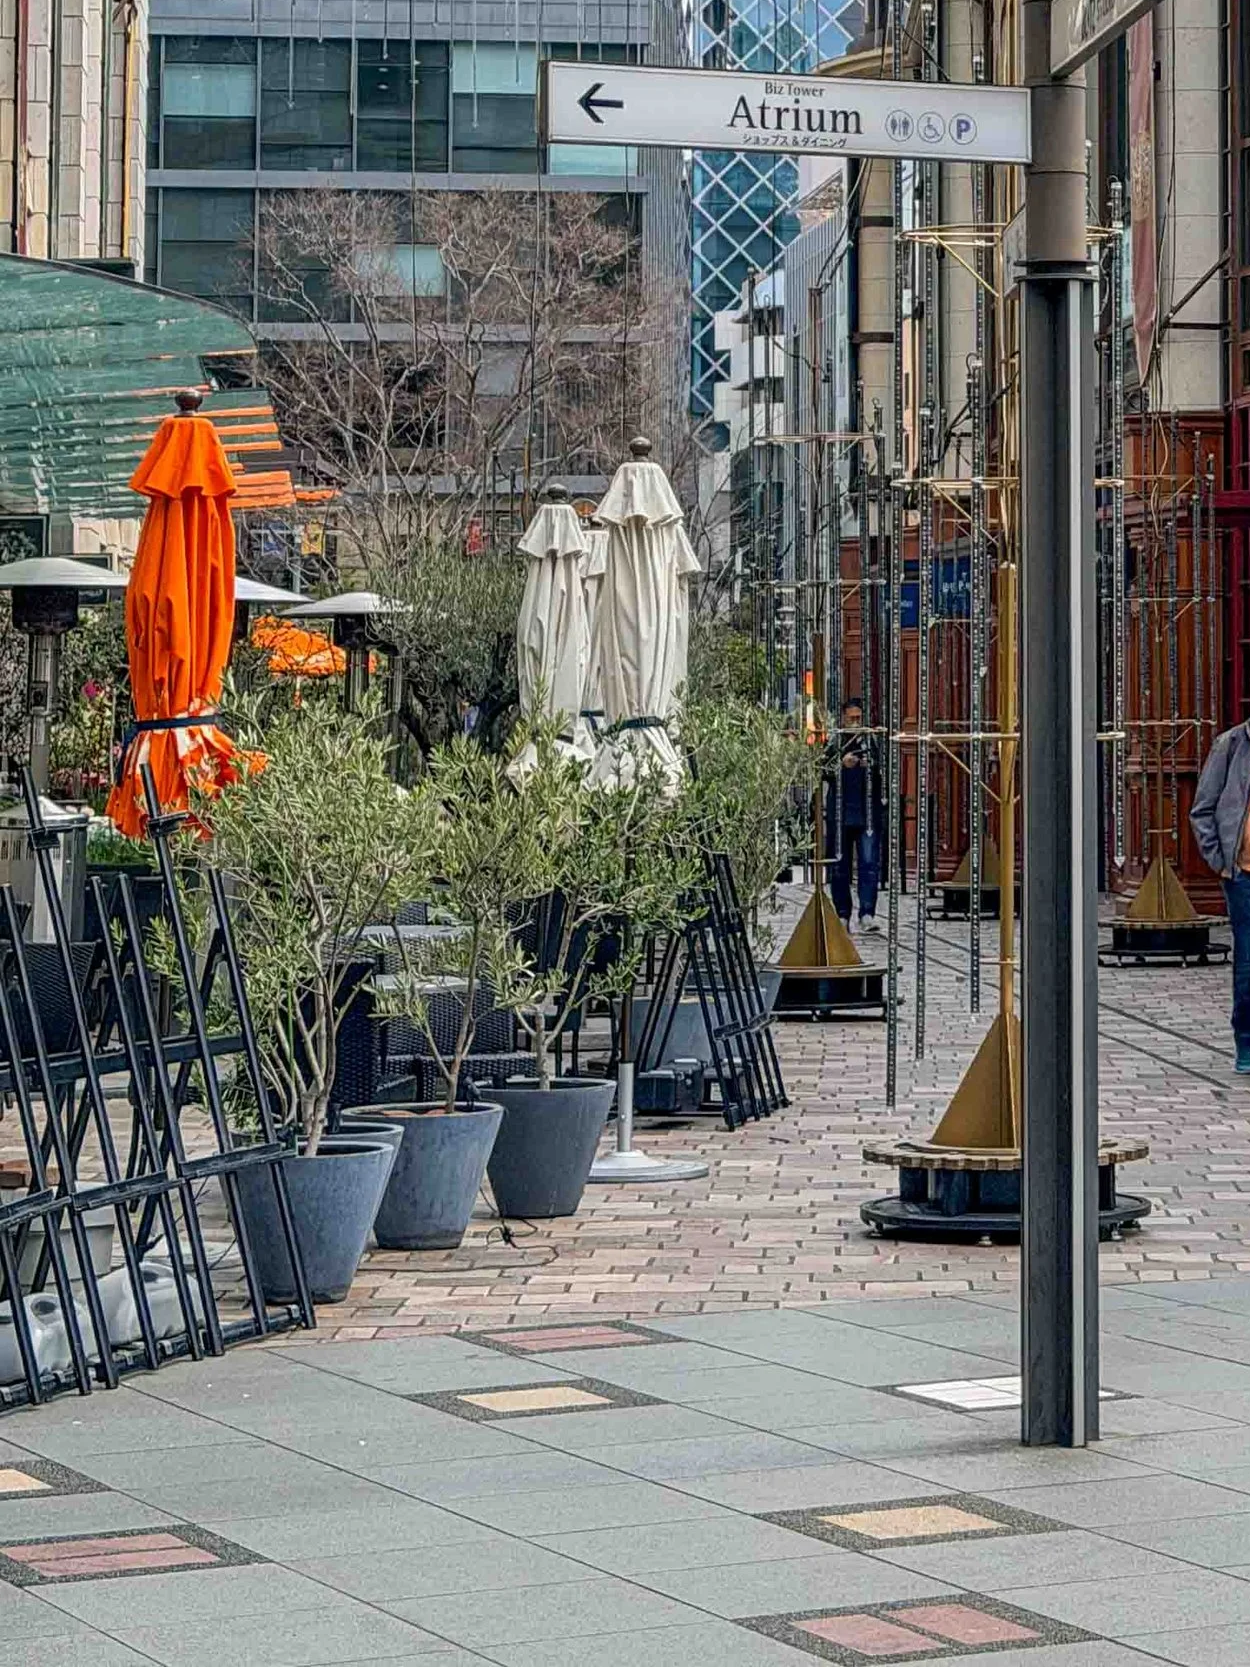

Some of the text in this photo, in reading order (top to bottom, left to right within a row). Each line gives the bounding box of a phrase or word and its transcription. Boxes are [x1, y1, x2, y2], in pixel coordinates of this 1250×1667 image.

[764, 81, 826, 98] Biz Tower
[727, 94, 864, 135] Atrium
